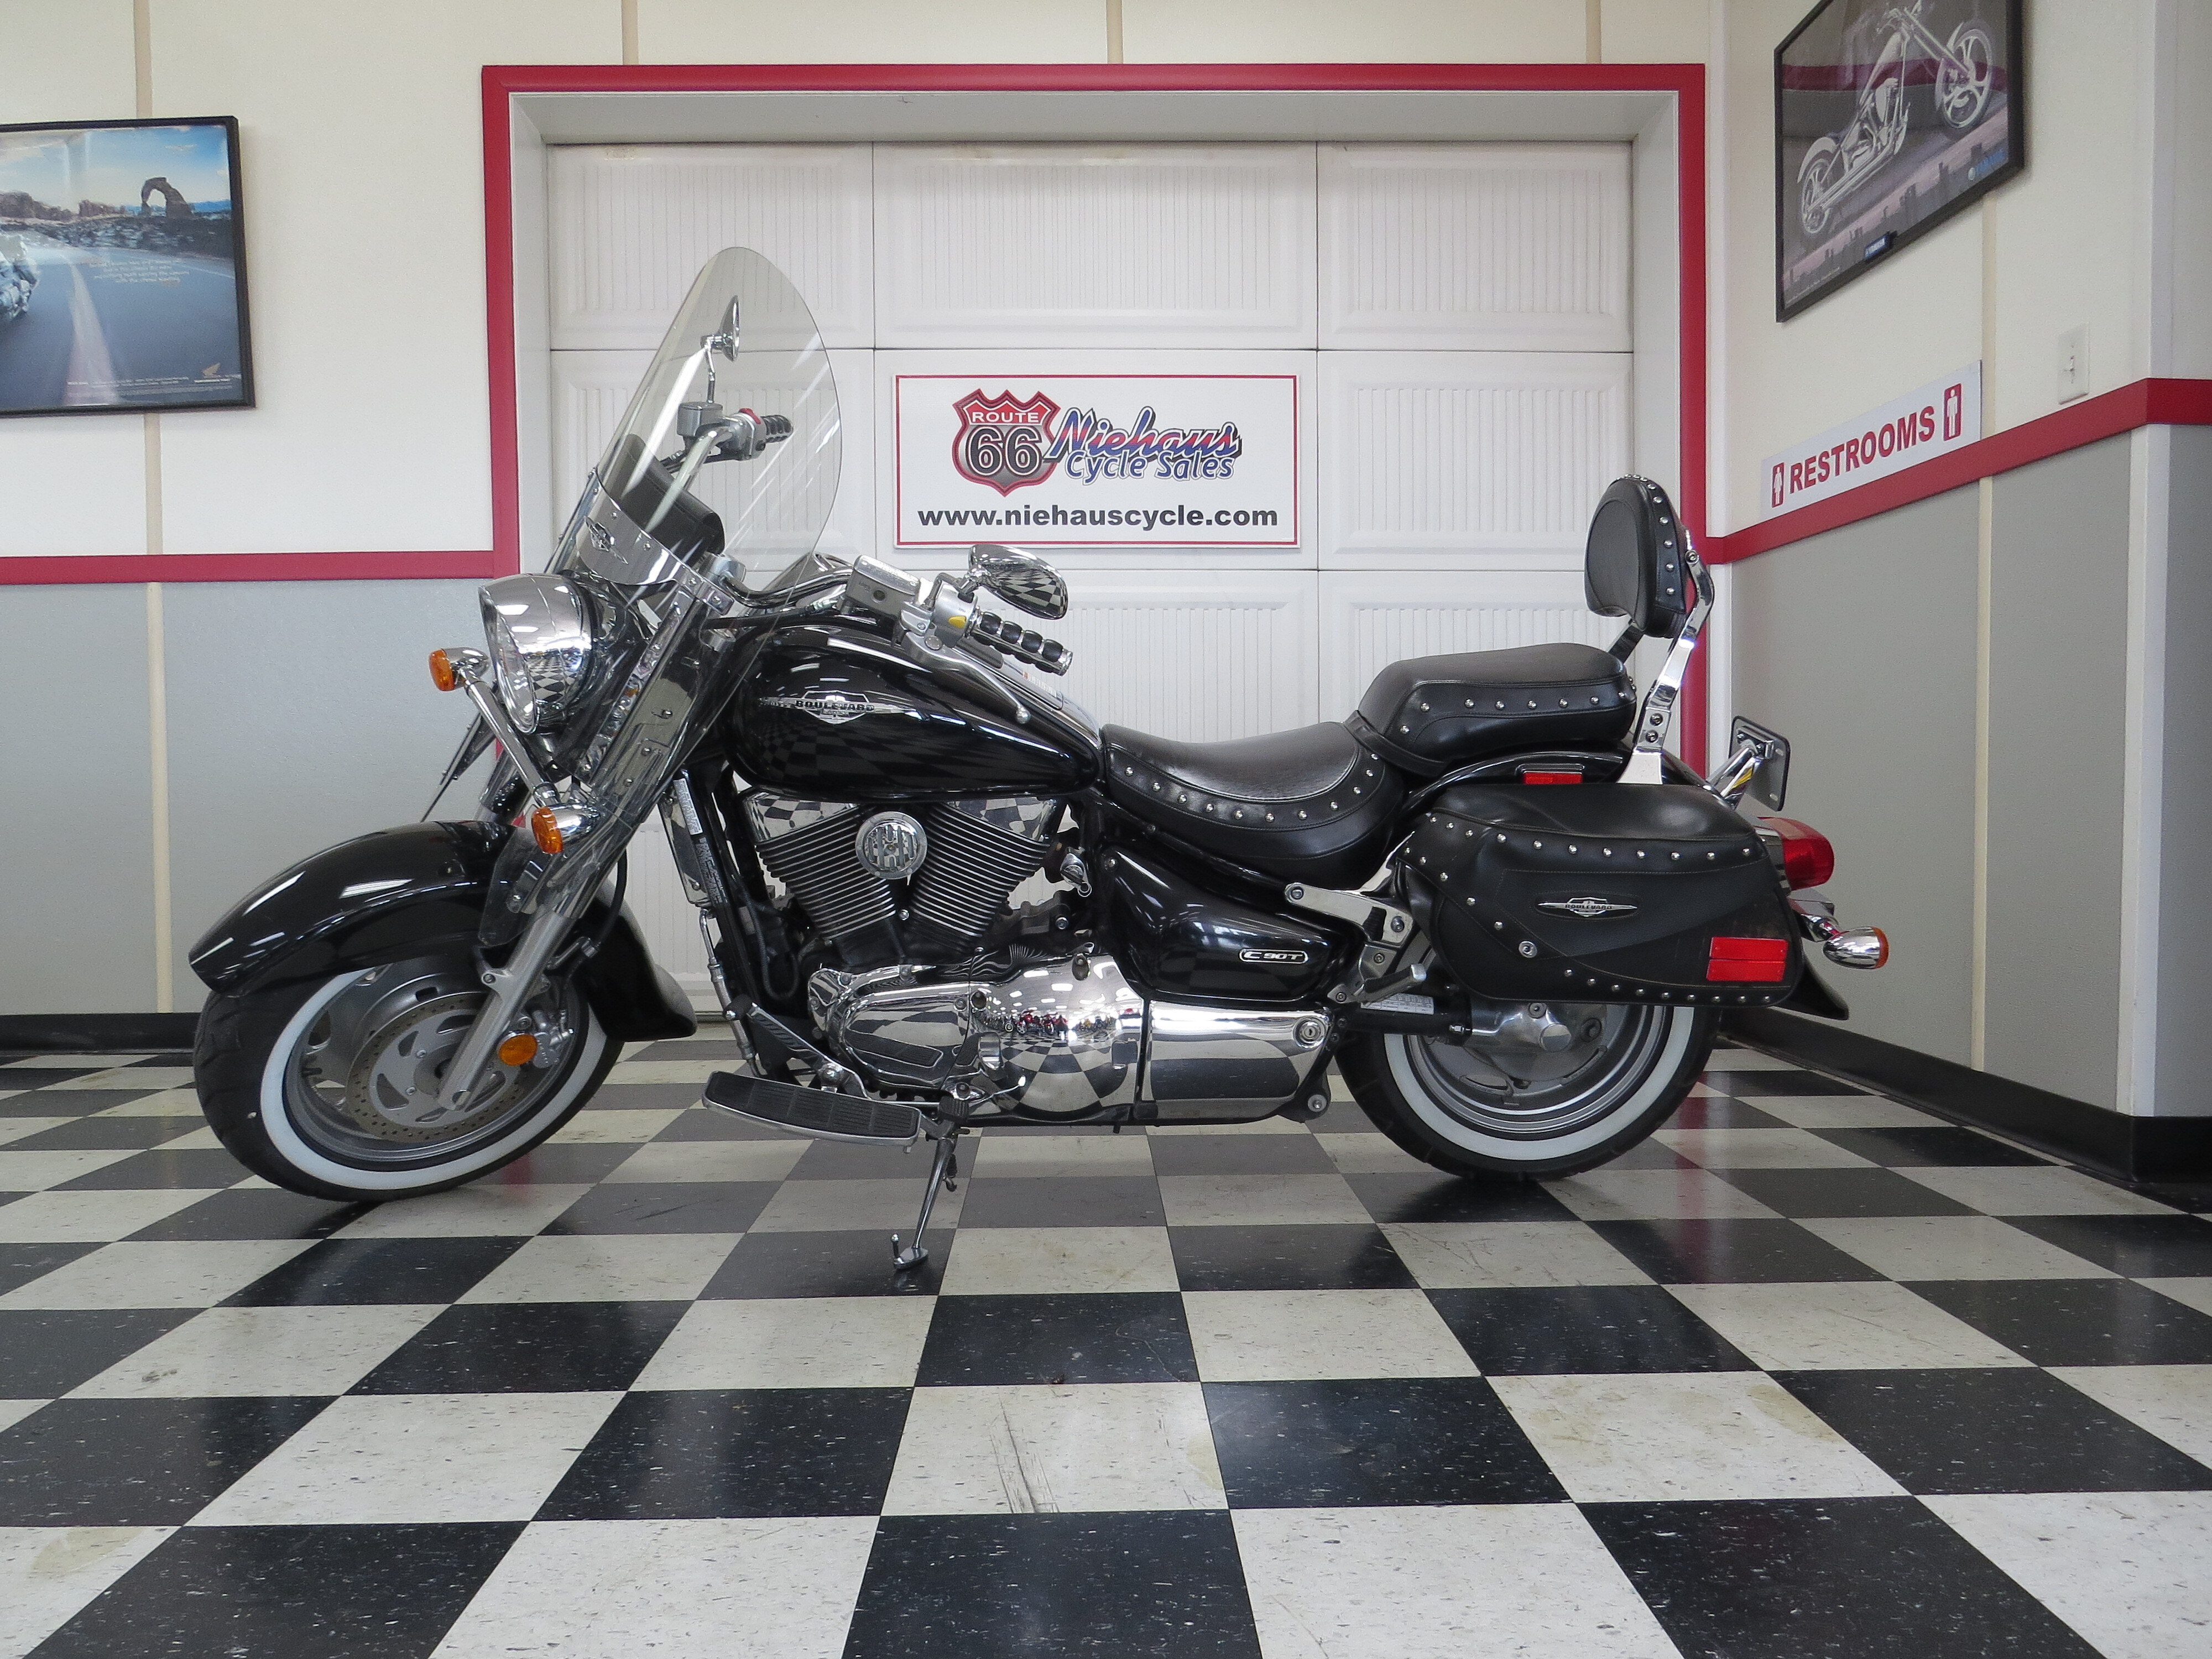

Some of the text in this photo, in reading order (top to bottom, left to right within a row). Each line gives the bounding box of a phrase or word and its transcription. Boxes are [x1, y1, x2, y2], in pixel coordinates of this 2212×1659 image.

[972, 411, 1039, 423] ROUTE
[1044, 406, 1243, 463] Niehaus
[966, 425, 1042, 476] 66
[1790, 405, 1935, 494] RESTROOMS
[1066, 450, 1236, 486] Cycle Sales
[917, 505, 1277, 531] www.niehauscycle.com
[795, 700, 875, 712] BOULEVARD
